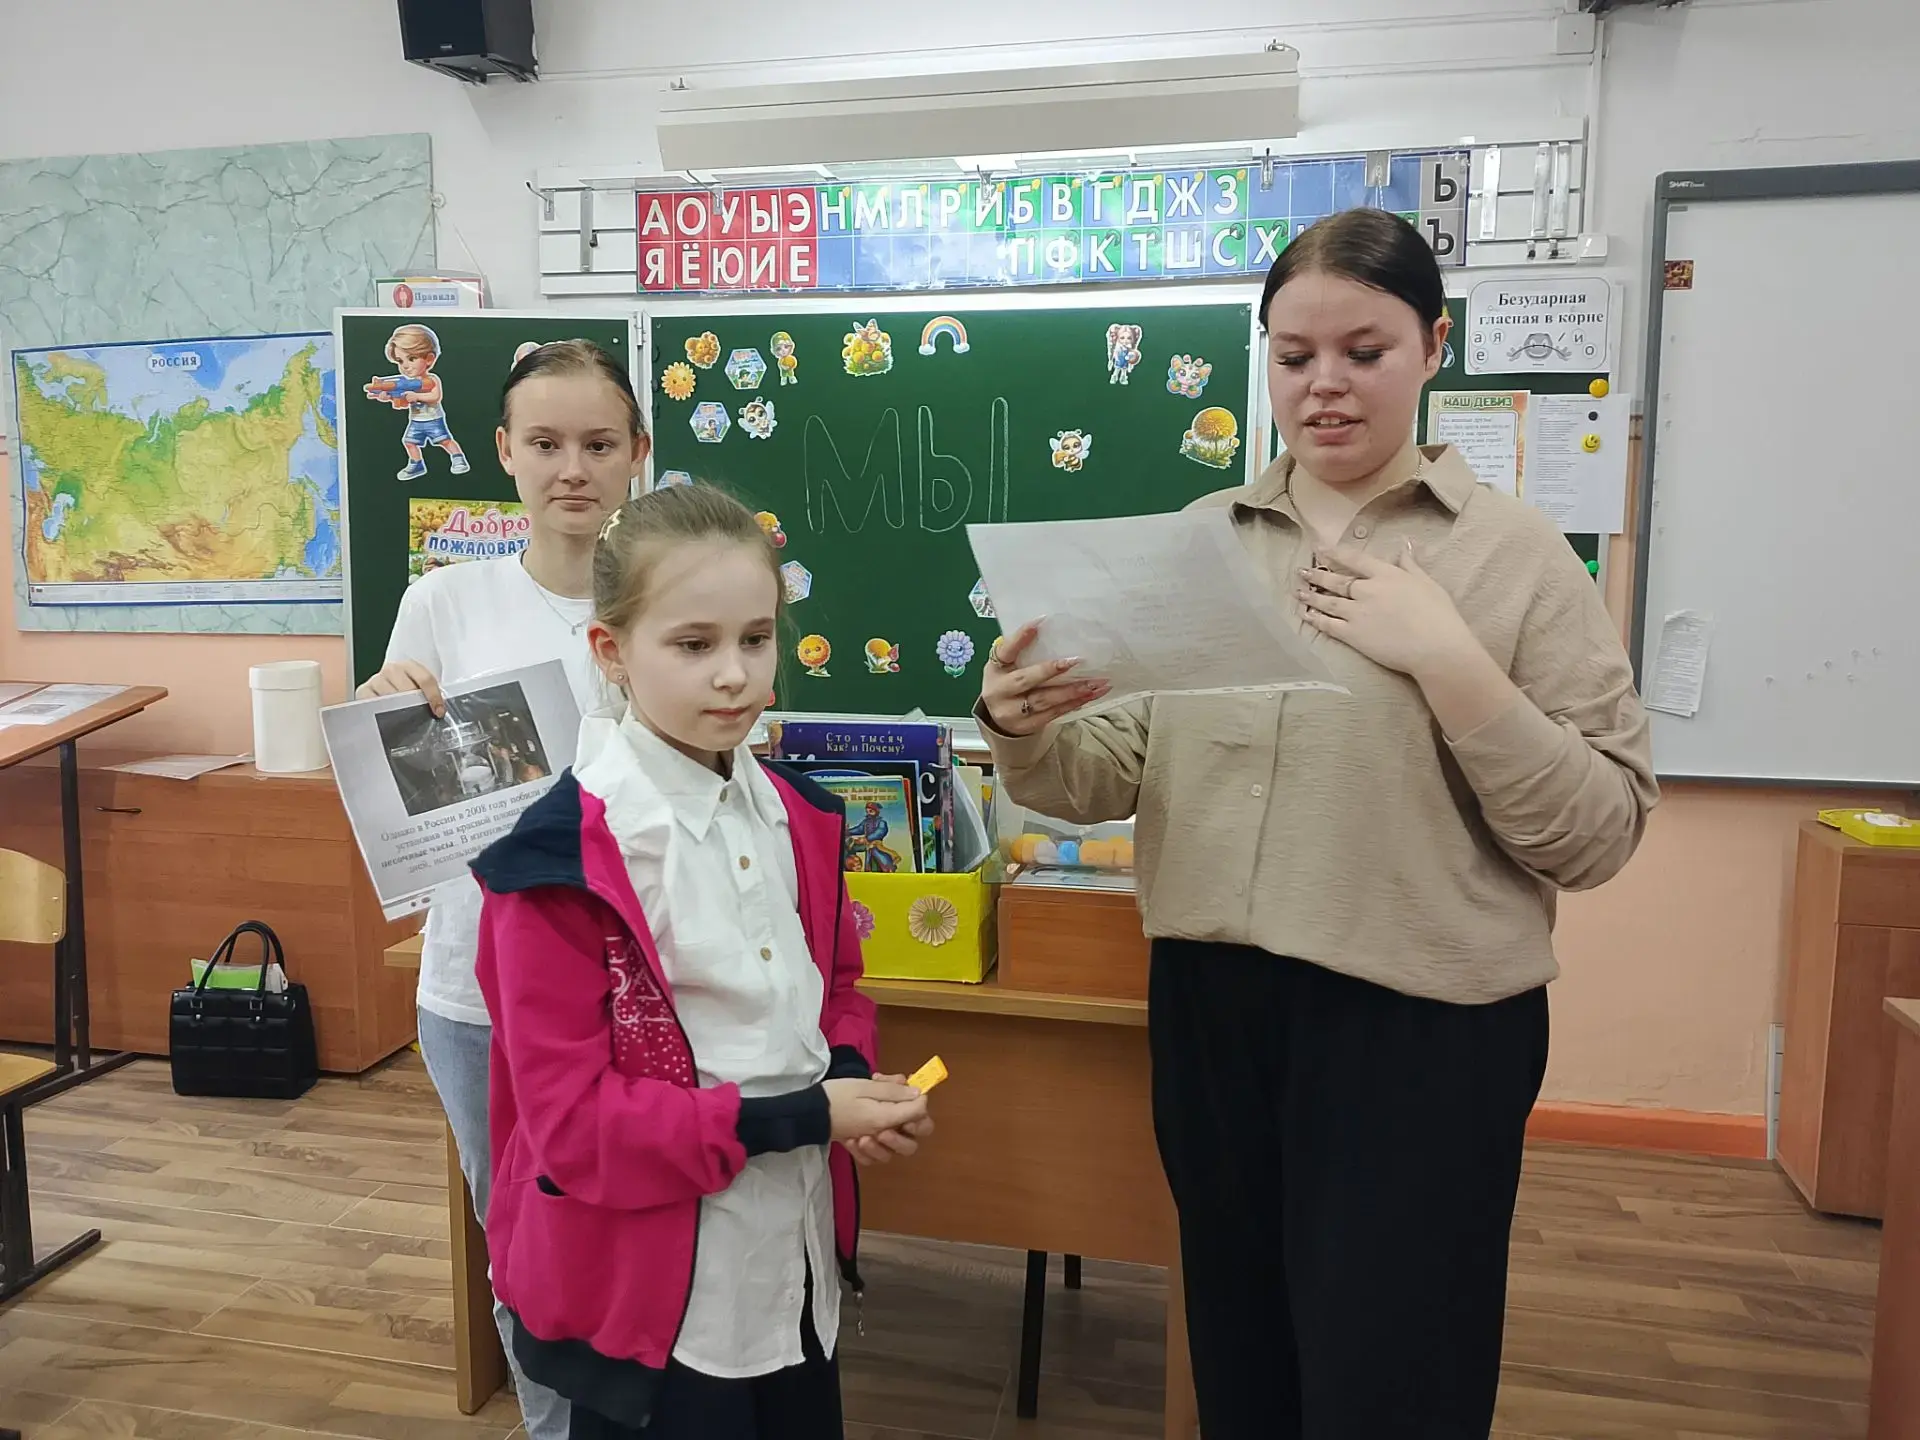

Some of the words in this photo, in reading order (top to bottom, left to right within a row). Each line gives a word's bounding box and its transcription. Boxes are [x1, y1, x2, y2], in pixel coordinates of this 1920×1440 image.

[1498, 291, 1586, 308] Безударная
[1479, 314, 1539, 325] гласная
[1545, 314, 1553, 323] в
[1558, 312, 1604, 326] корне
[151, 356, 197, 368] РОССИЯ
[1443, 396, 1471, 407] НАШ
[804, 397, 1009, 533] МЫ
[443, 509, 530, 538] Добро
[826, 732, 851, 743] Сто
[860, 735, 903, 744] тысяч
[826, 743, 848, 752] Как?
[852, 744, 858, 752] и
[862, 742, 905, 755] Почему?
[381, 827, 416, 841] Однако
[424, 815, 457, 830] России
[465, 804, 487, 818] 2008
[488, 800, 507, 811] году
[456, 816, 491, 834] красной
[381, 849, 428, 868] песочные
[460, 834, 469, 845] В
